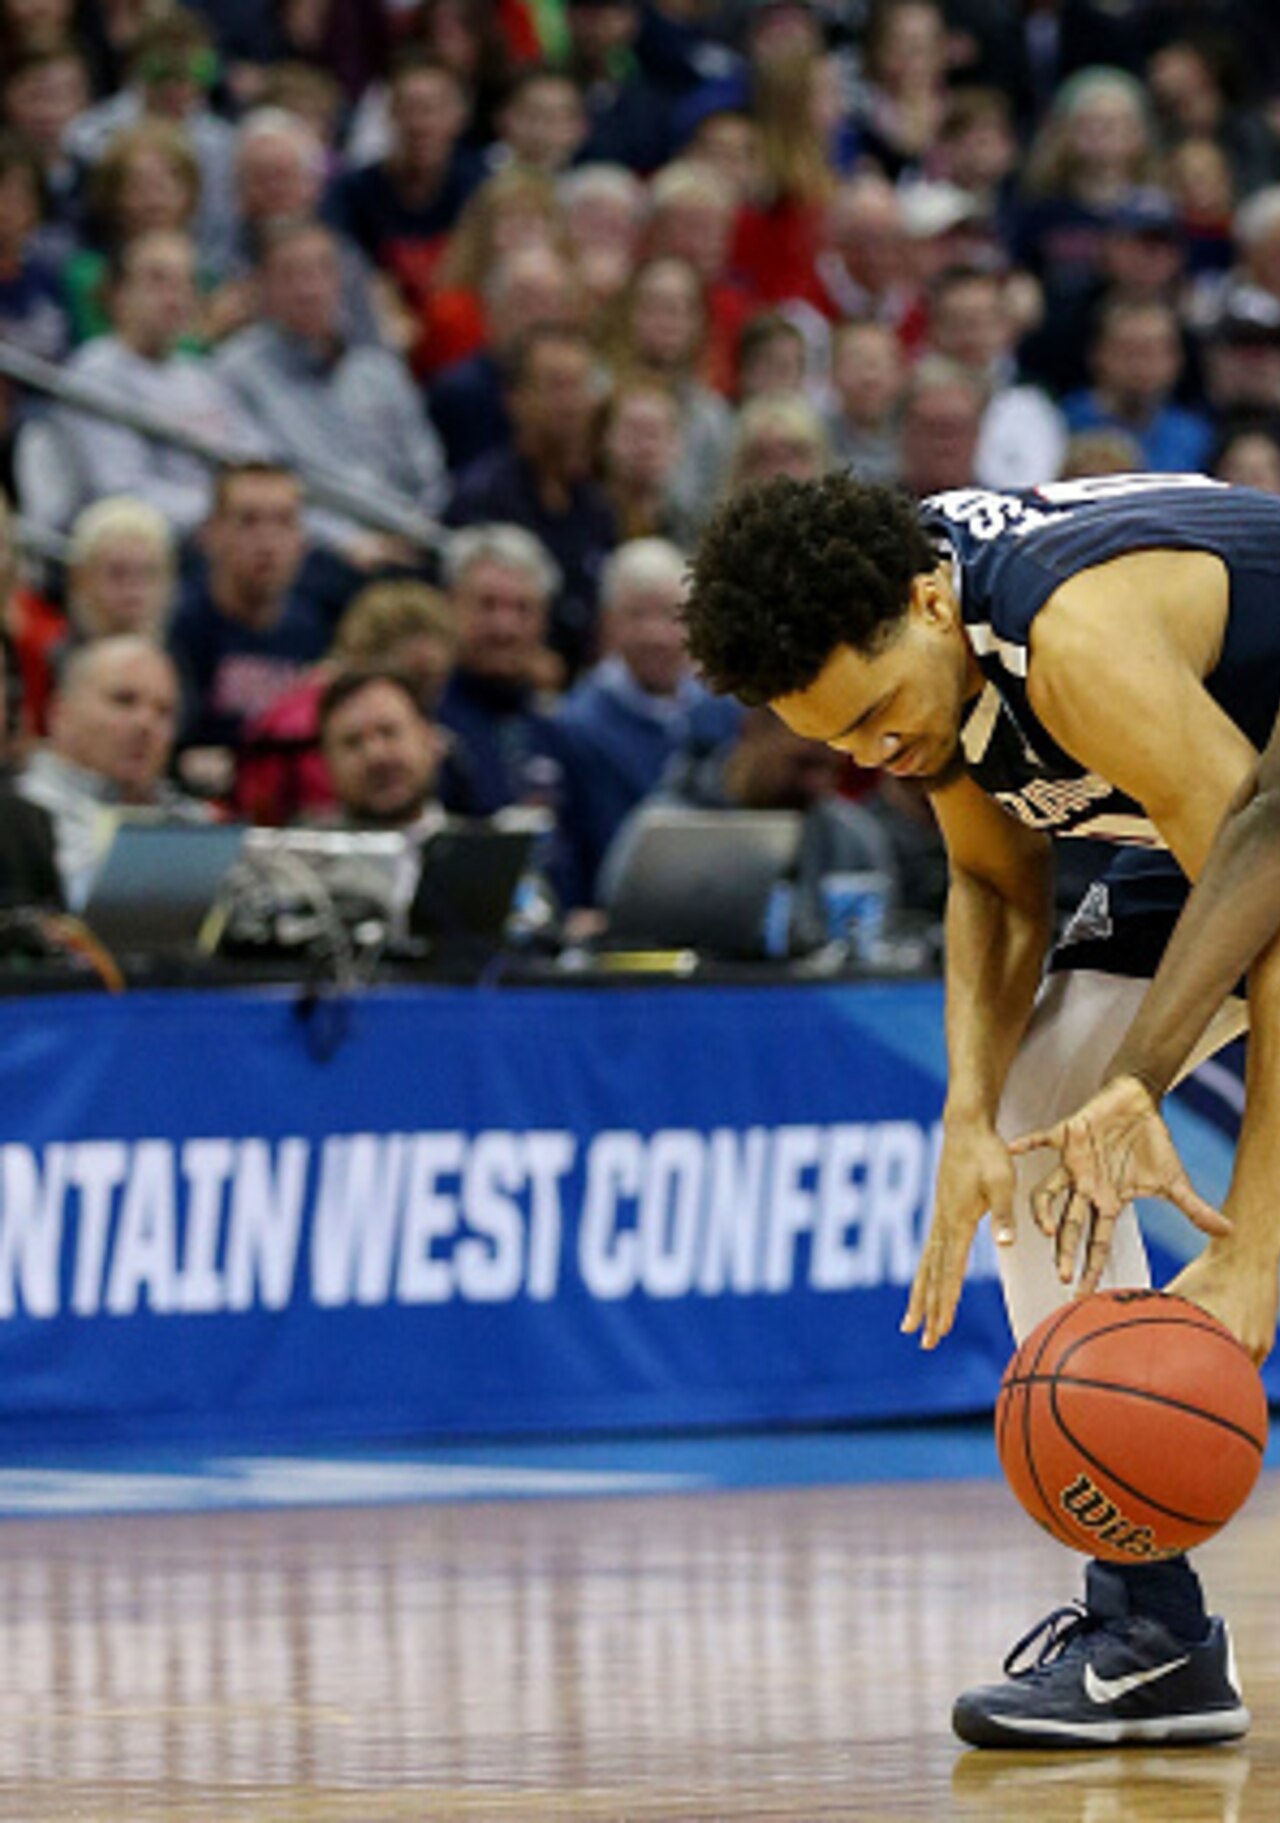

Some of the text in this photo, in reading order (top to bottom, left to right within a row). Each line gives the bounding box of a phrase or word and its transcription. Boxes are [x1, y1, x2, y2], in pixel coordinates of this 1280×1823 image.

[311, 1130, 577, 1308] WEST
[578, 1121, 945, 1300] CONFER
[1060, 1471, 1184, 1560] Wils
